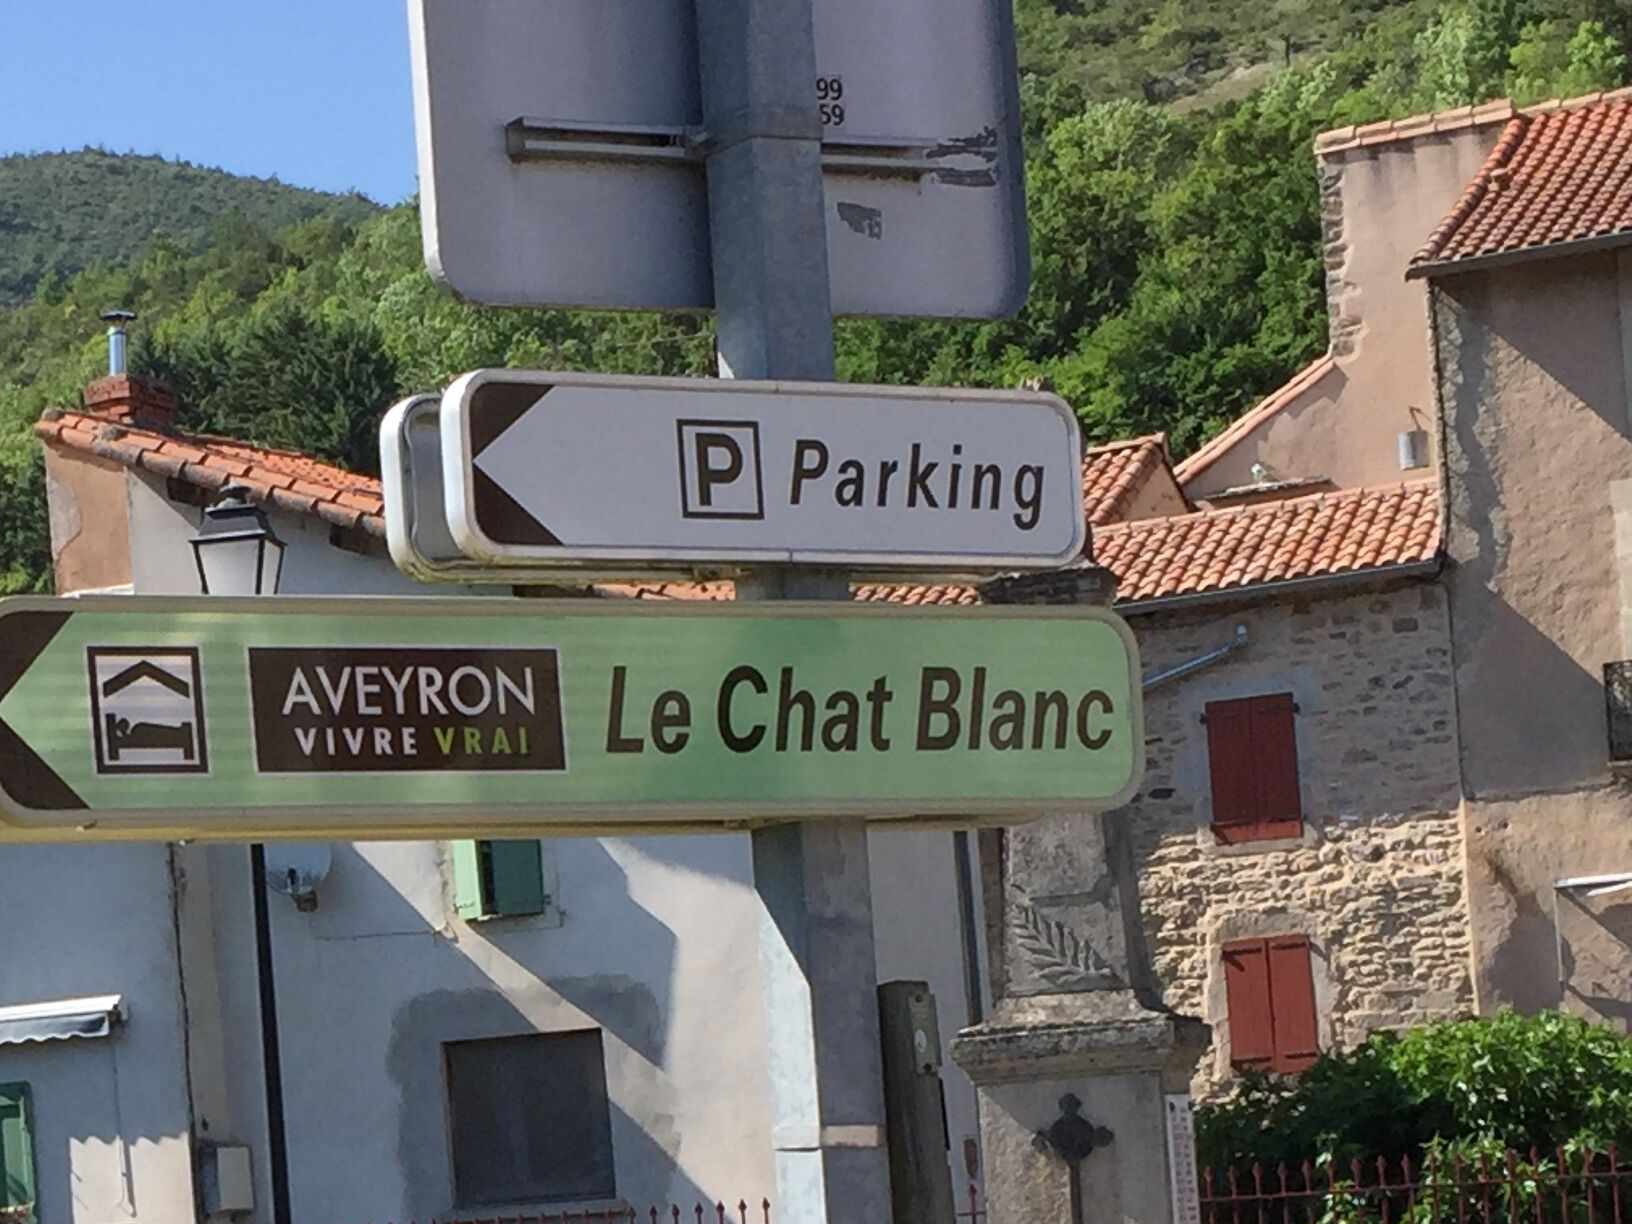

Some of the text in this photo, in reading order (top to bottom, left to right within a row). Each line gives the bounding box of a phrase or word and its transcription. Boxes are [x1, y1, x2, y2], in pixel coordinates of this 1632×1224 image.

[816, 78, 843, 101] 99
[819, 104, 845, 127] 59
[694, 432, 1045, 531] P Parking
[281, 665, 536, 717] AVEYRON
[605, 665, 1115, 754] Le Chat Blanc
[294, 725, 529, 756] VIVRE VRAI
